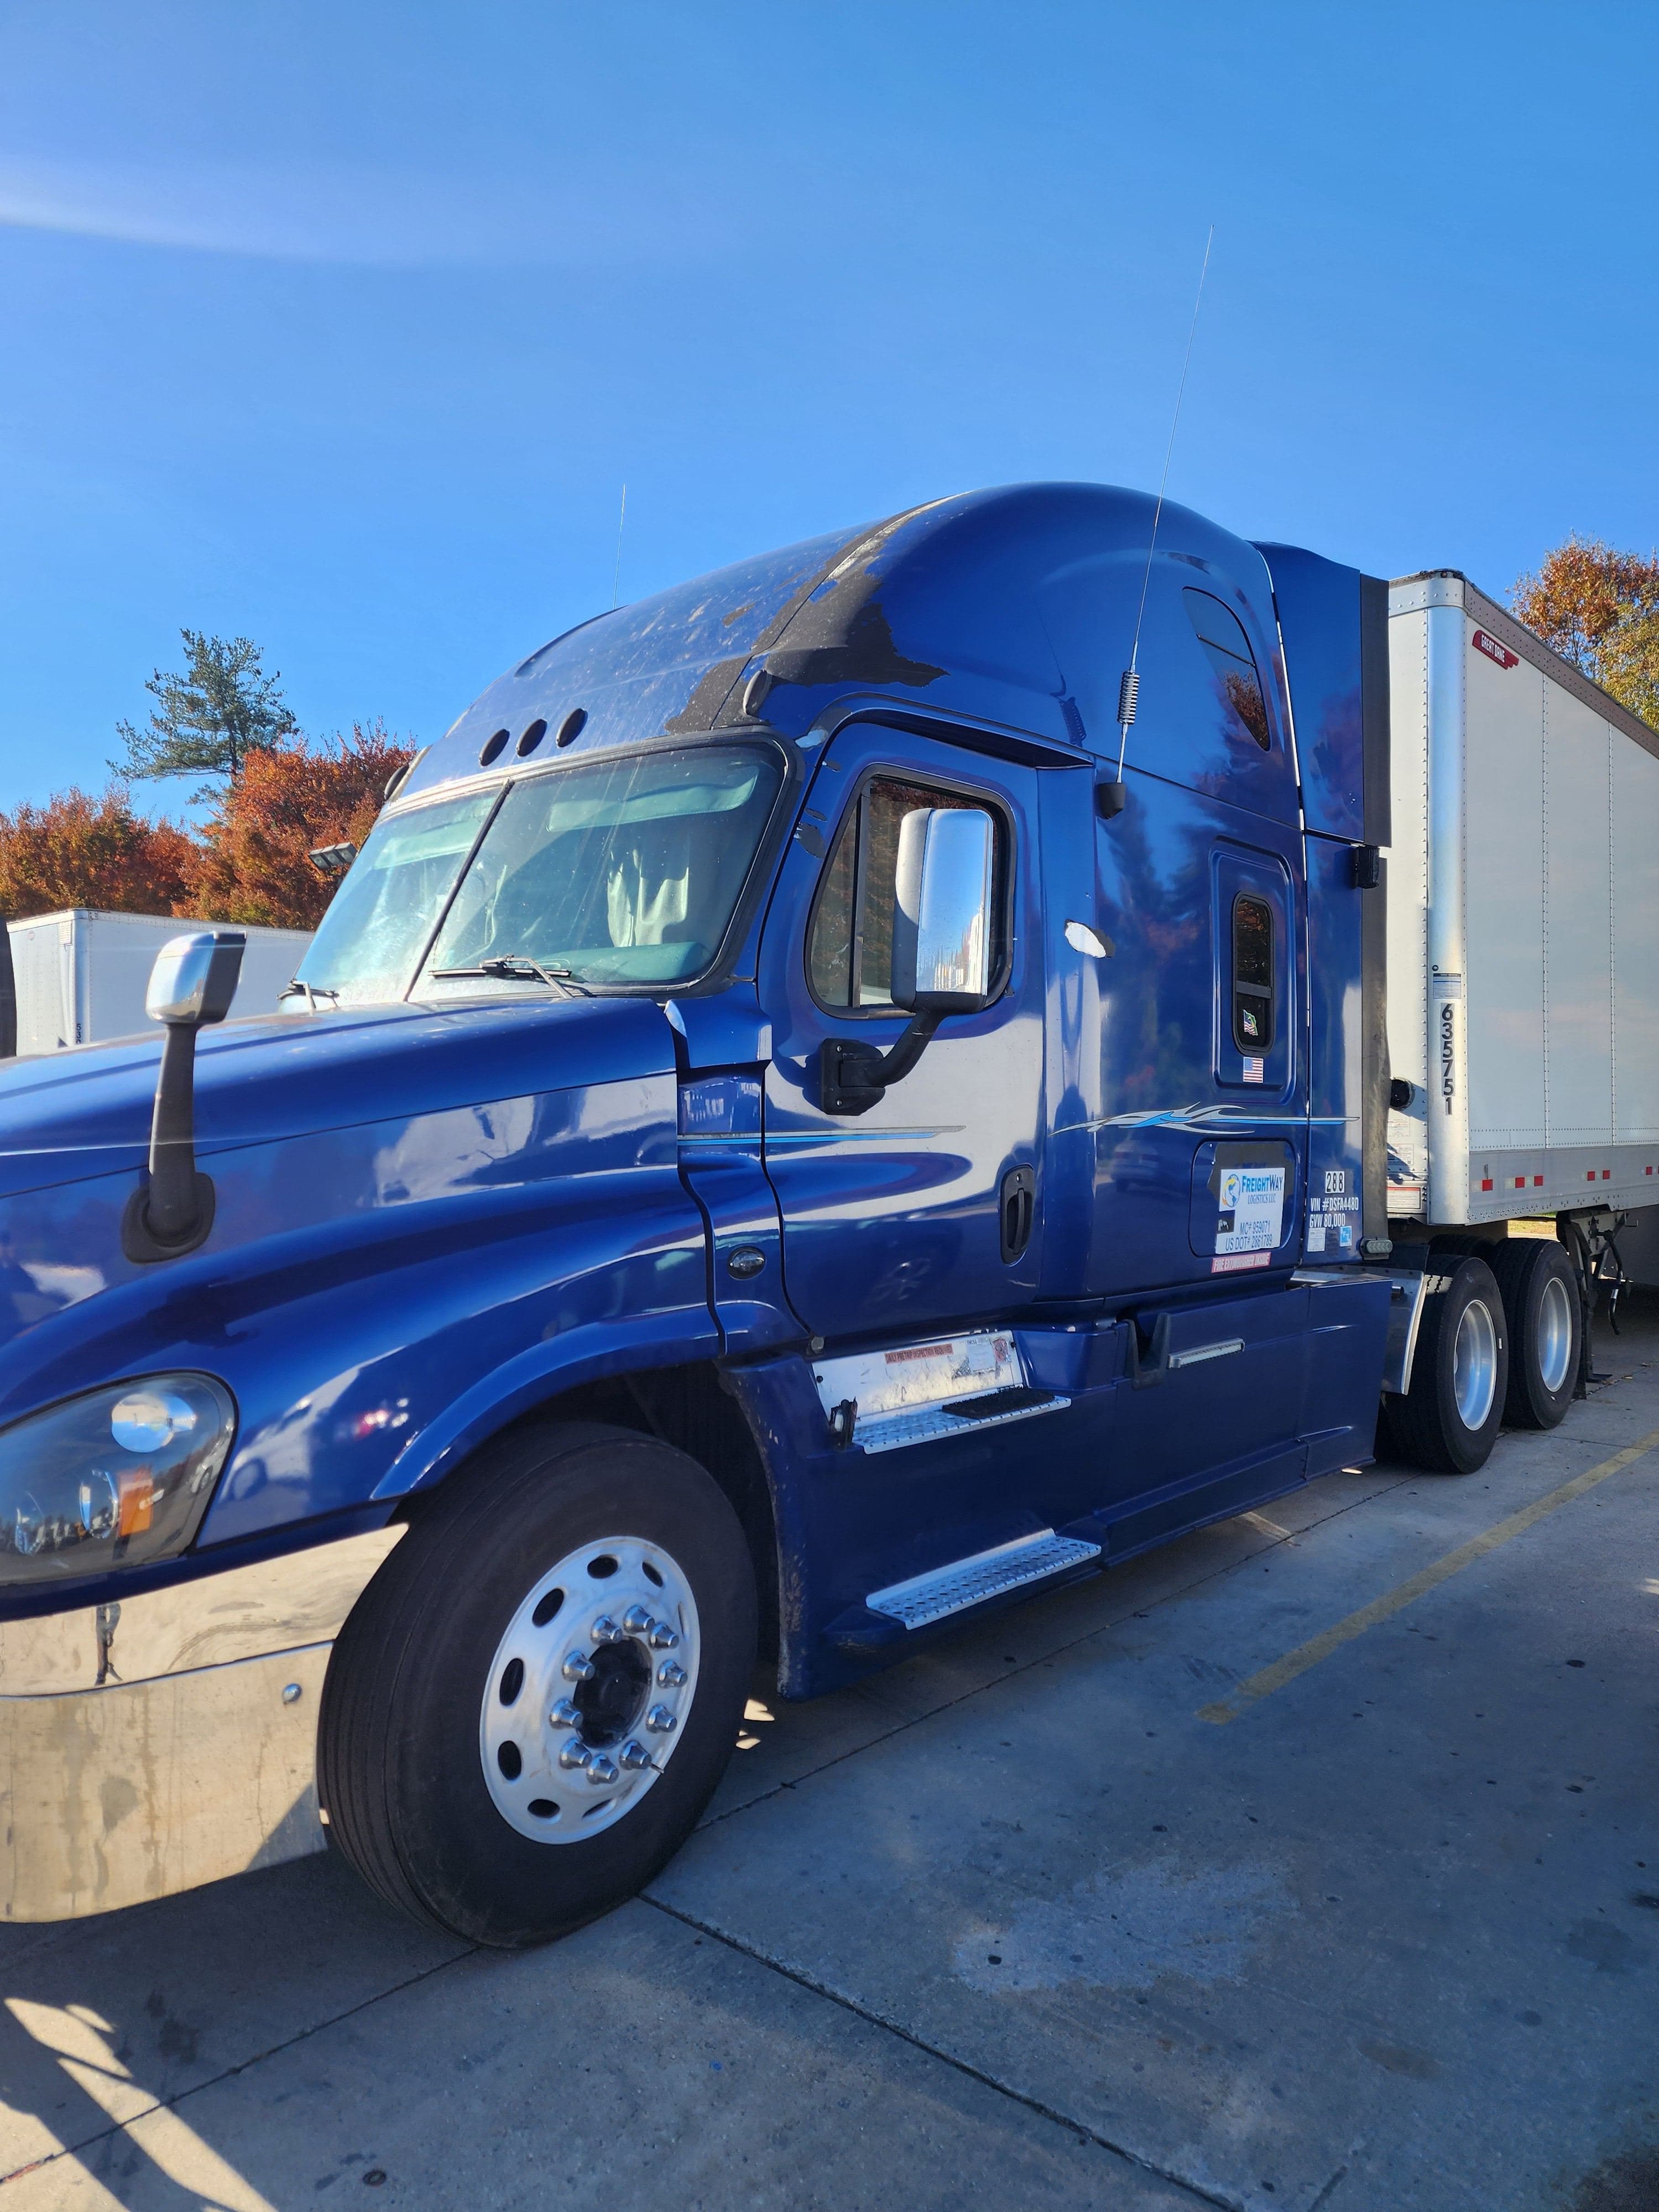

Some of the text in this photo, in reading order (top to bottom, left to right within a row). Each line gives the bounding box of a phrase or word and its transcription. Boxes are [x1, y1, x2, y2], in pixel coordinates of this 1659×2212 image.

[1481, 634, 1505, 663] GREAT DANE
[1442, 1003, 1454, 1115] 635751
[1326, 1172, 1343, 1192] 288
[1248, 1194, 1268, 1204] LOGISTICS
[1311, 1197, 1359, 1212] VIN #DSFA4480
[1240, 1220, 1270, 1235] MC# 959071
[1310, 1213, 1345, 1229] GVW 80,000
[1225, 1234, 1272, 1251] US DOT# 2861789
[935, 1344, 952, 1355] REQUED
